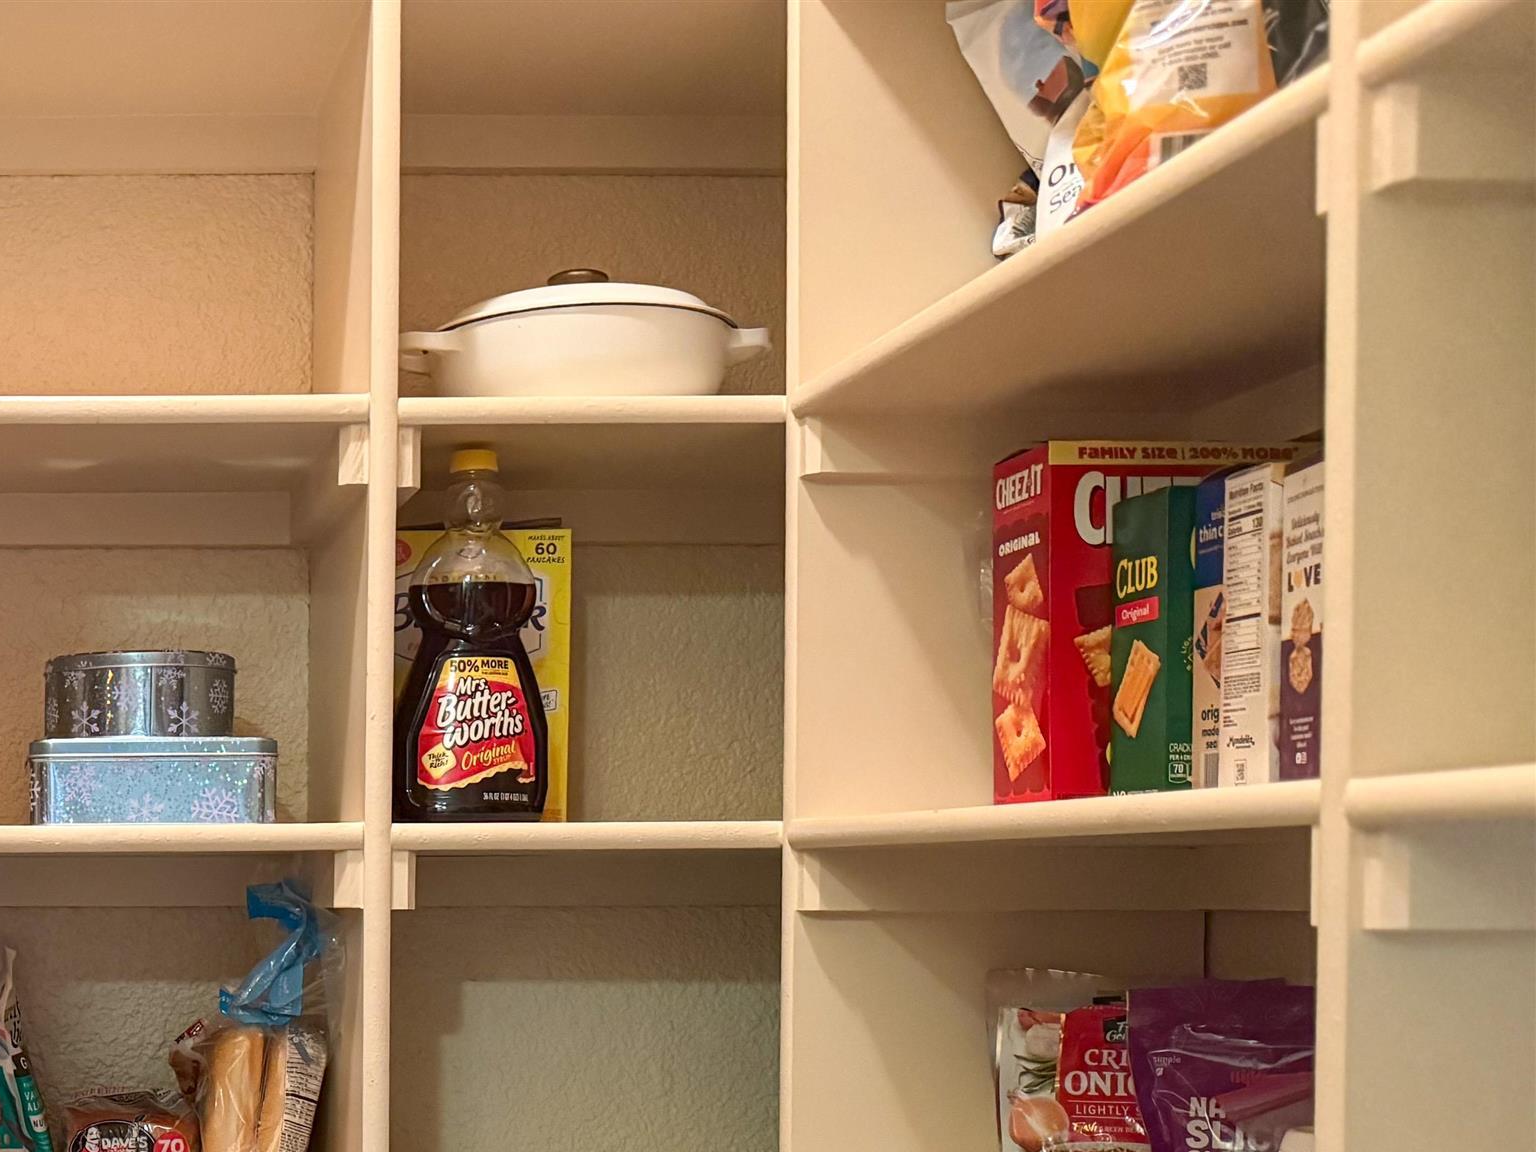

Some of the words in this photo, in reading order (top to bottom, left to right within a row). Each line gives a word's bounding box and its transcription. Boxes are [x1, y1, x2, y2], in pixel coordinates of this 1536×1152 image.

[535, 543, 557, 555] 60
[526, 556, 565, 564] PANCAKES
[1116, 555, 1158, 599] CLUB
[1121, 604, 1149, 621] Original
[450, 660, 480, 673] 50%
[481, 660, 509, 669] MORE
[456, 675, 488, 696] Mrs.
[436, 688, 516, 728] Butter-
[442, 709, 523, 749] worth's
[461, 741, 516, 770] Original
[1173, 764, 1184, 773] 70
[1076, 1103, 1129, 1116] LIGHTLY
[101, 1136, 148, 1150] DAVE'S
